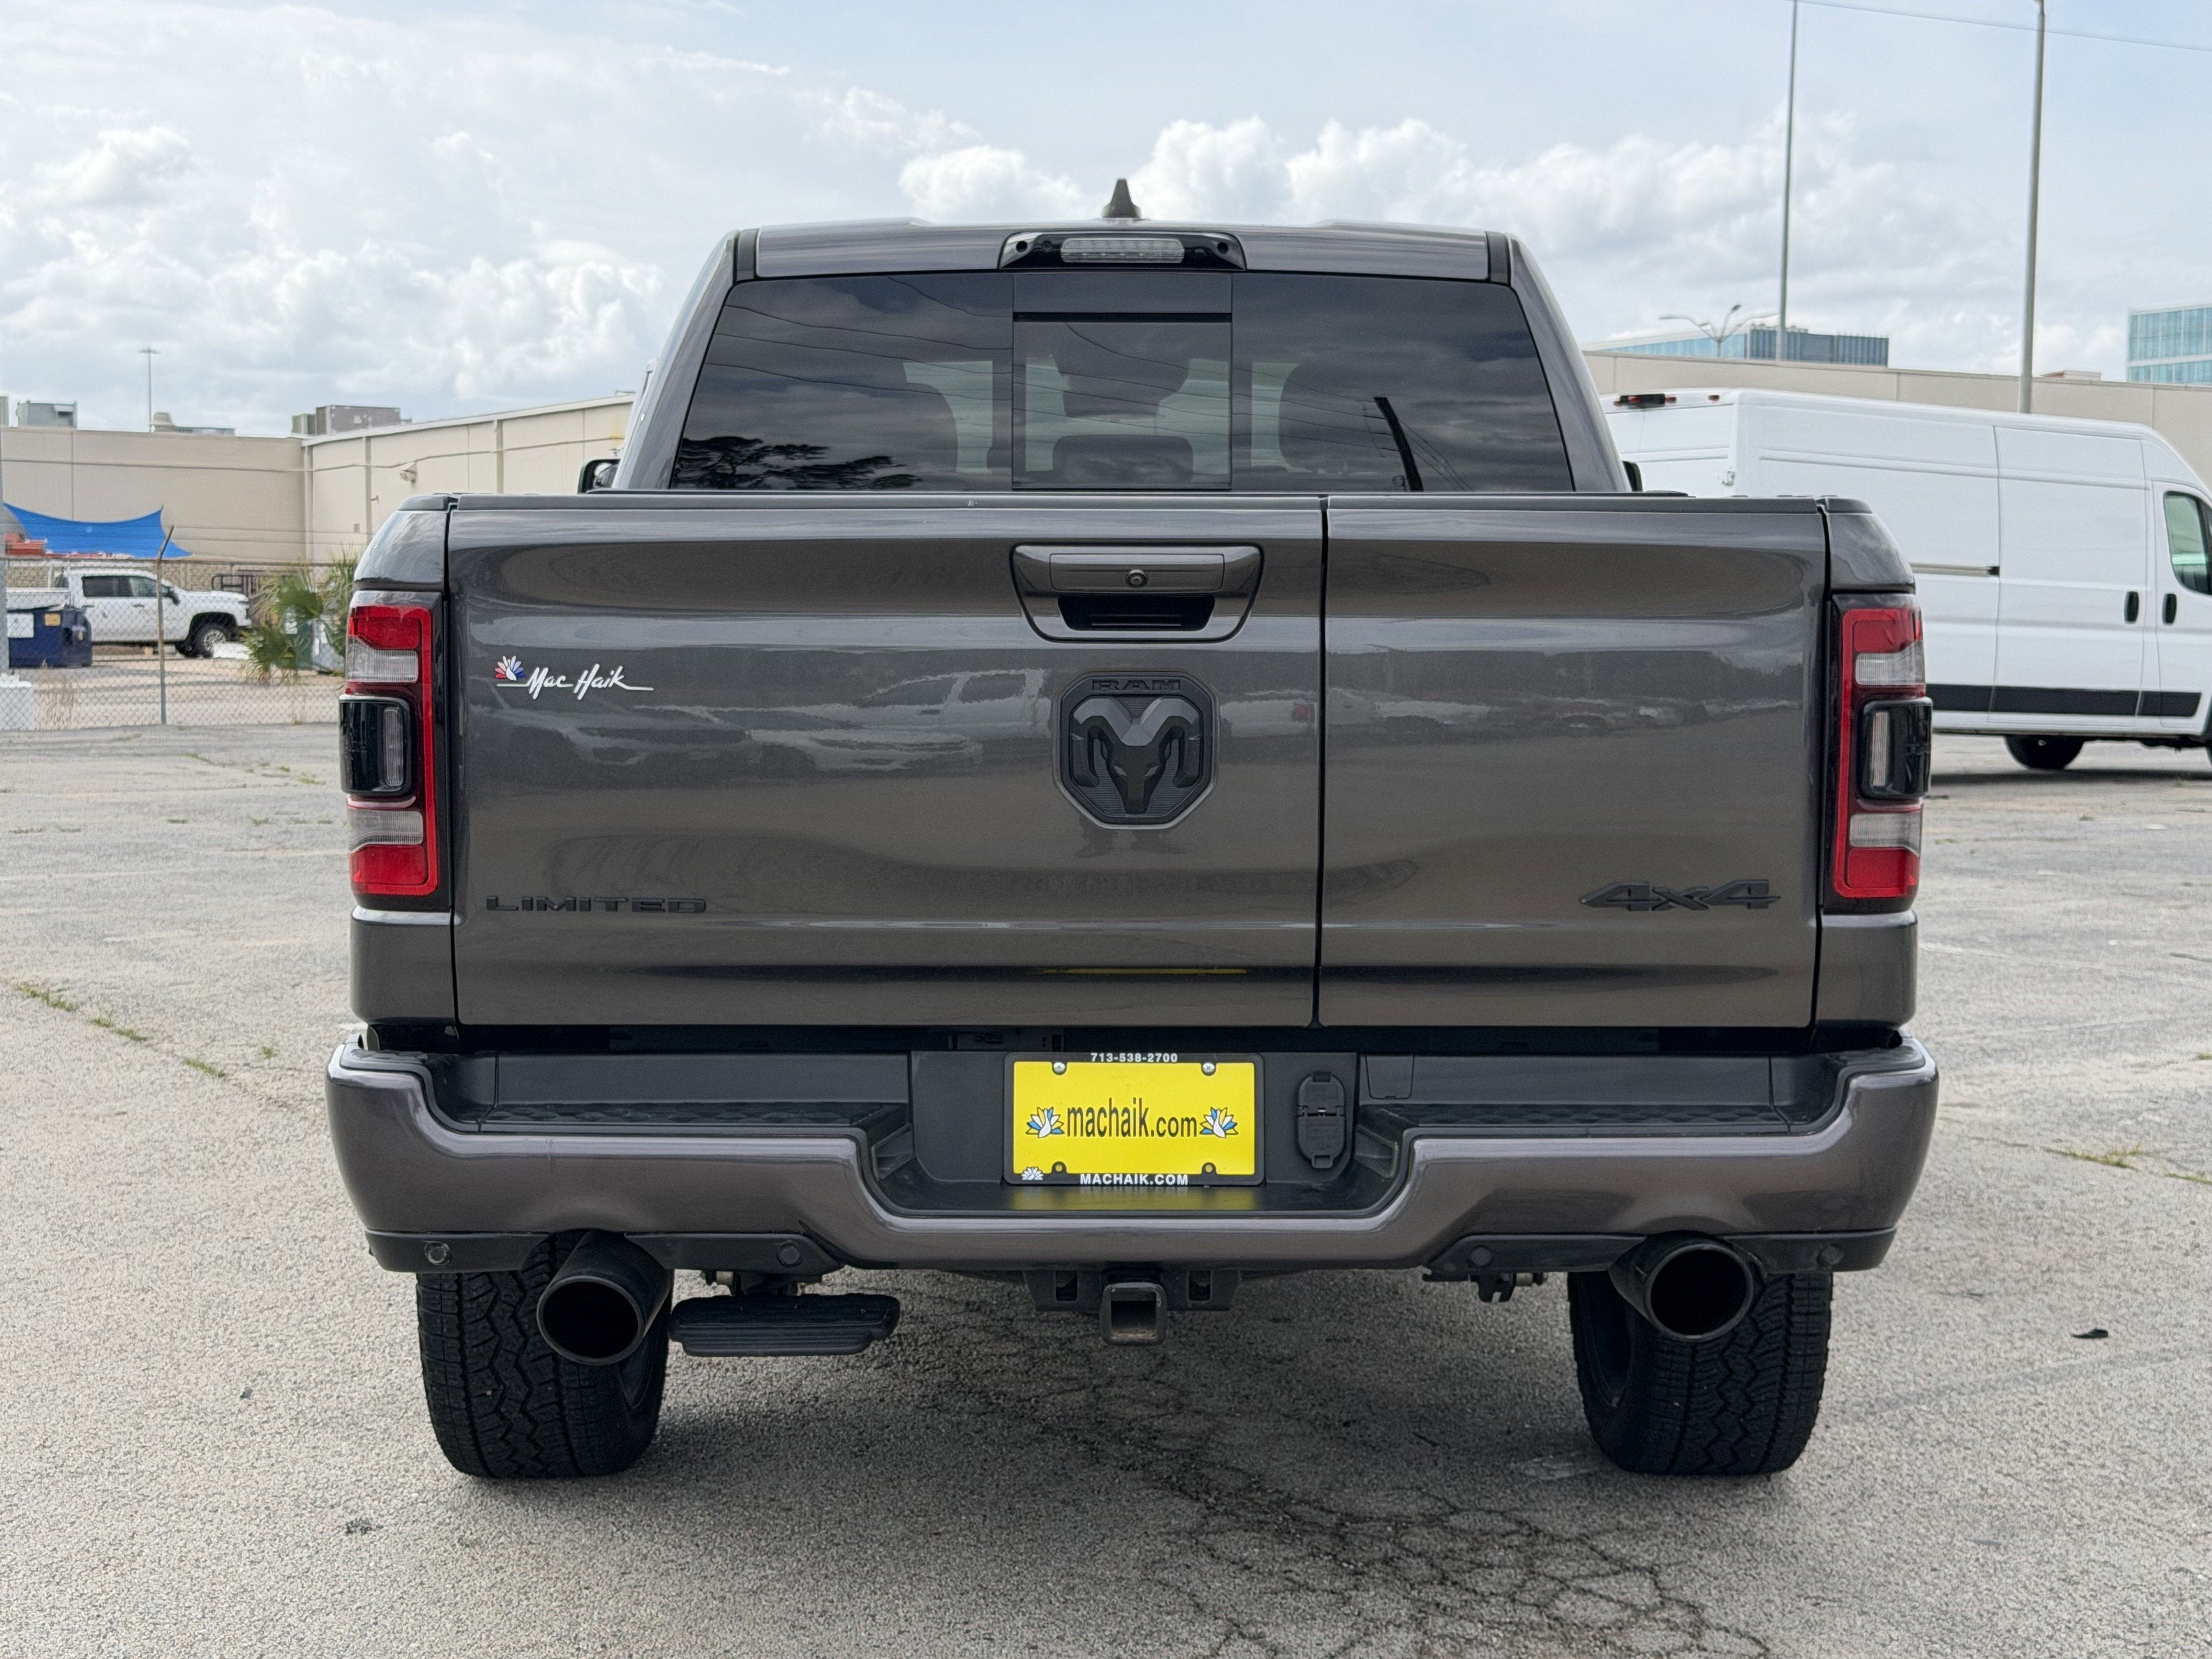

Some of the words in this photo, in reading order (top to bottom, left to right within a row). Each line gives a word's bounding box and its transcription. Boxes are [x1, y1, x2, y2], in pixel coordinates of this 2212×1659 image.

[496, 667, 574, 700] Mac
[573, 663, 654, 701] Haik
[1092, 680, 1181, 691] RAM
[486, 895, 707, 913] LIMITED
[1091, 1053, 1178, 1063] 713-538-2700
[1066, 1097, 1198, 1138] machaik.com
[1080, 1173, 1188, 1186] MACHAIK.COM
